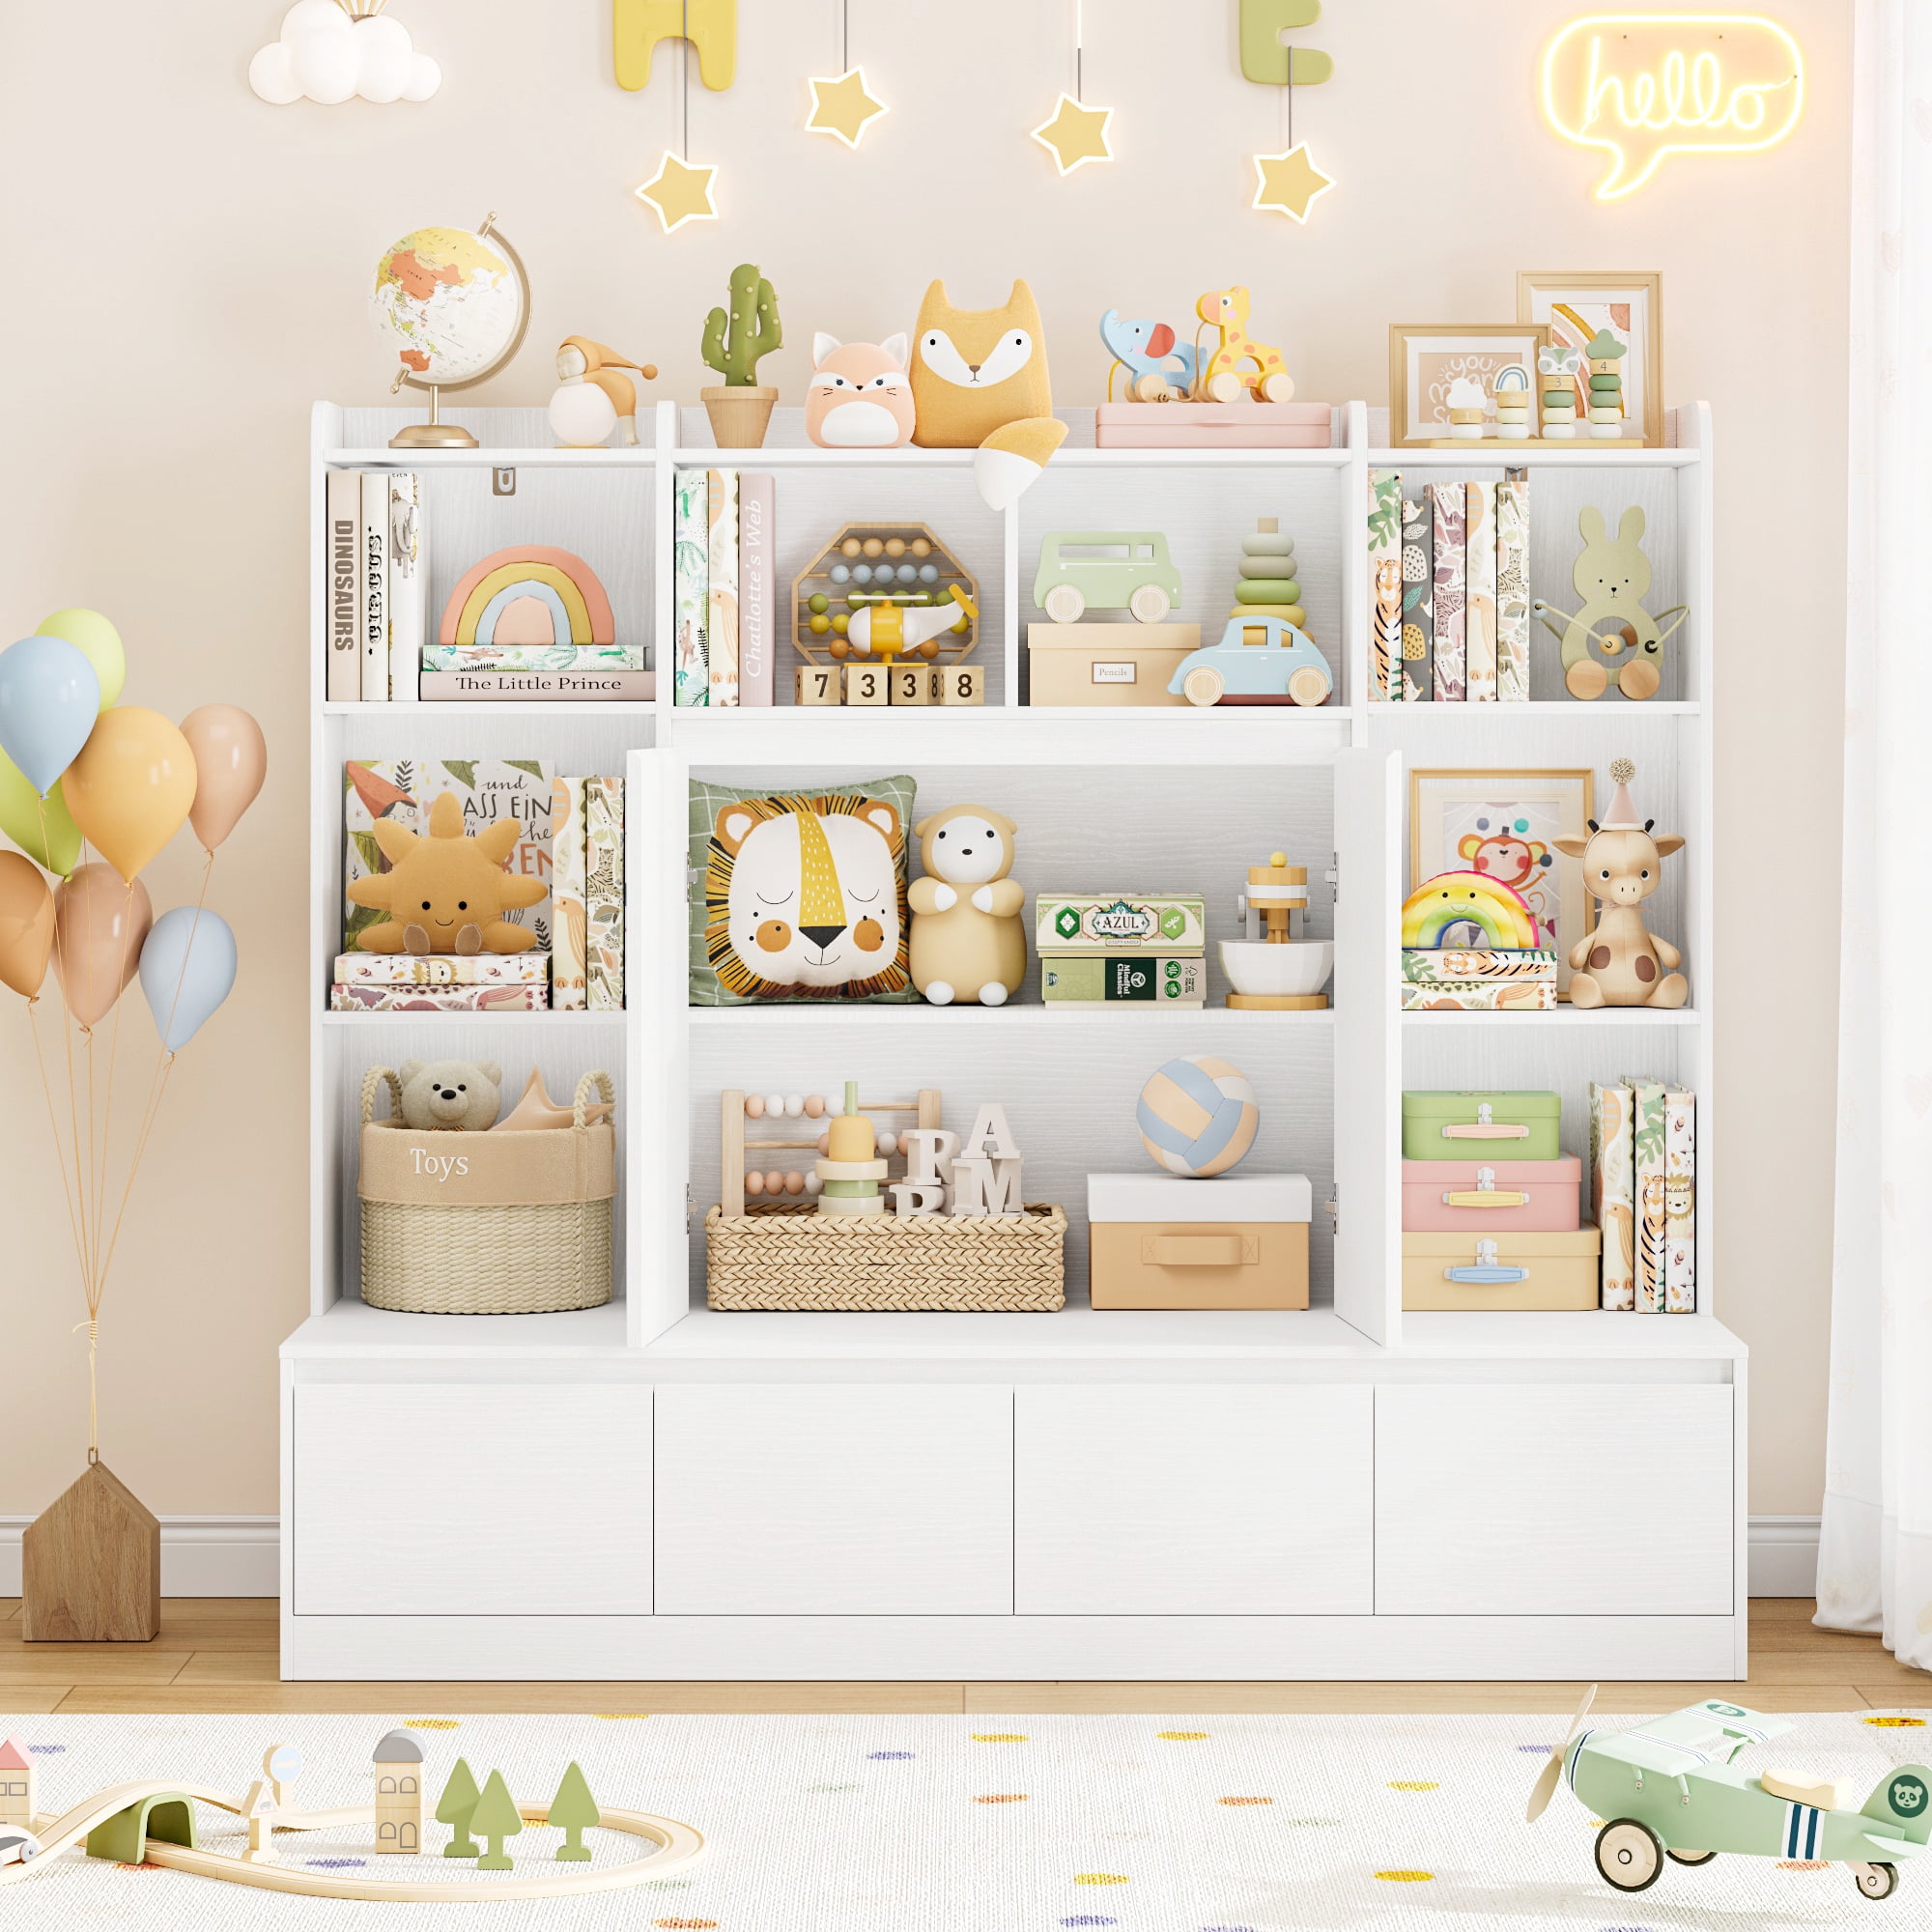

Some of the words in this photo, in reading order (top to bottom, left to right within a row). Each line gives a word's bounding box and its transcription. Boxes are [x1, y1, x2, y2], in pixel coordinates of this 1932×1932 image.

[1584, 35, 1776, 130] hello
[1554, 378, 1562, 388] 3
[1600, 360, 1607, 372] 4
[745, 499, 762, 548] Web
[334, 520, 355, 651] DINOSAURS
[368, 534, 383, 644] CIRCUS
[456, 677, 492, 690] The
[497, 677, 552, 690] Little
[557, 677, 621, 690] Prince
[814, 673, 828, 697] 7
[861, 673, 875, 697] 3
[902, 673, 917, 697] 3
[957, 673, 973, 697] 8
[1098, 668, 1128, 676] Pencils
[481, 775, 527, 790] und
[1102, 916, 1139, 928] AZUL
[961, 1103, 1021, 1158] A
[410, 1148, 469, 1182] Toys
[901, 1128, 958, 1186] R
[952, 1158, 1022, 1214] M
